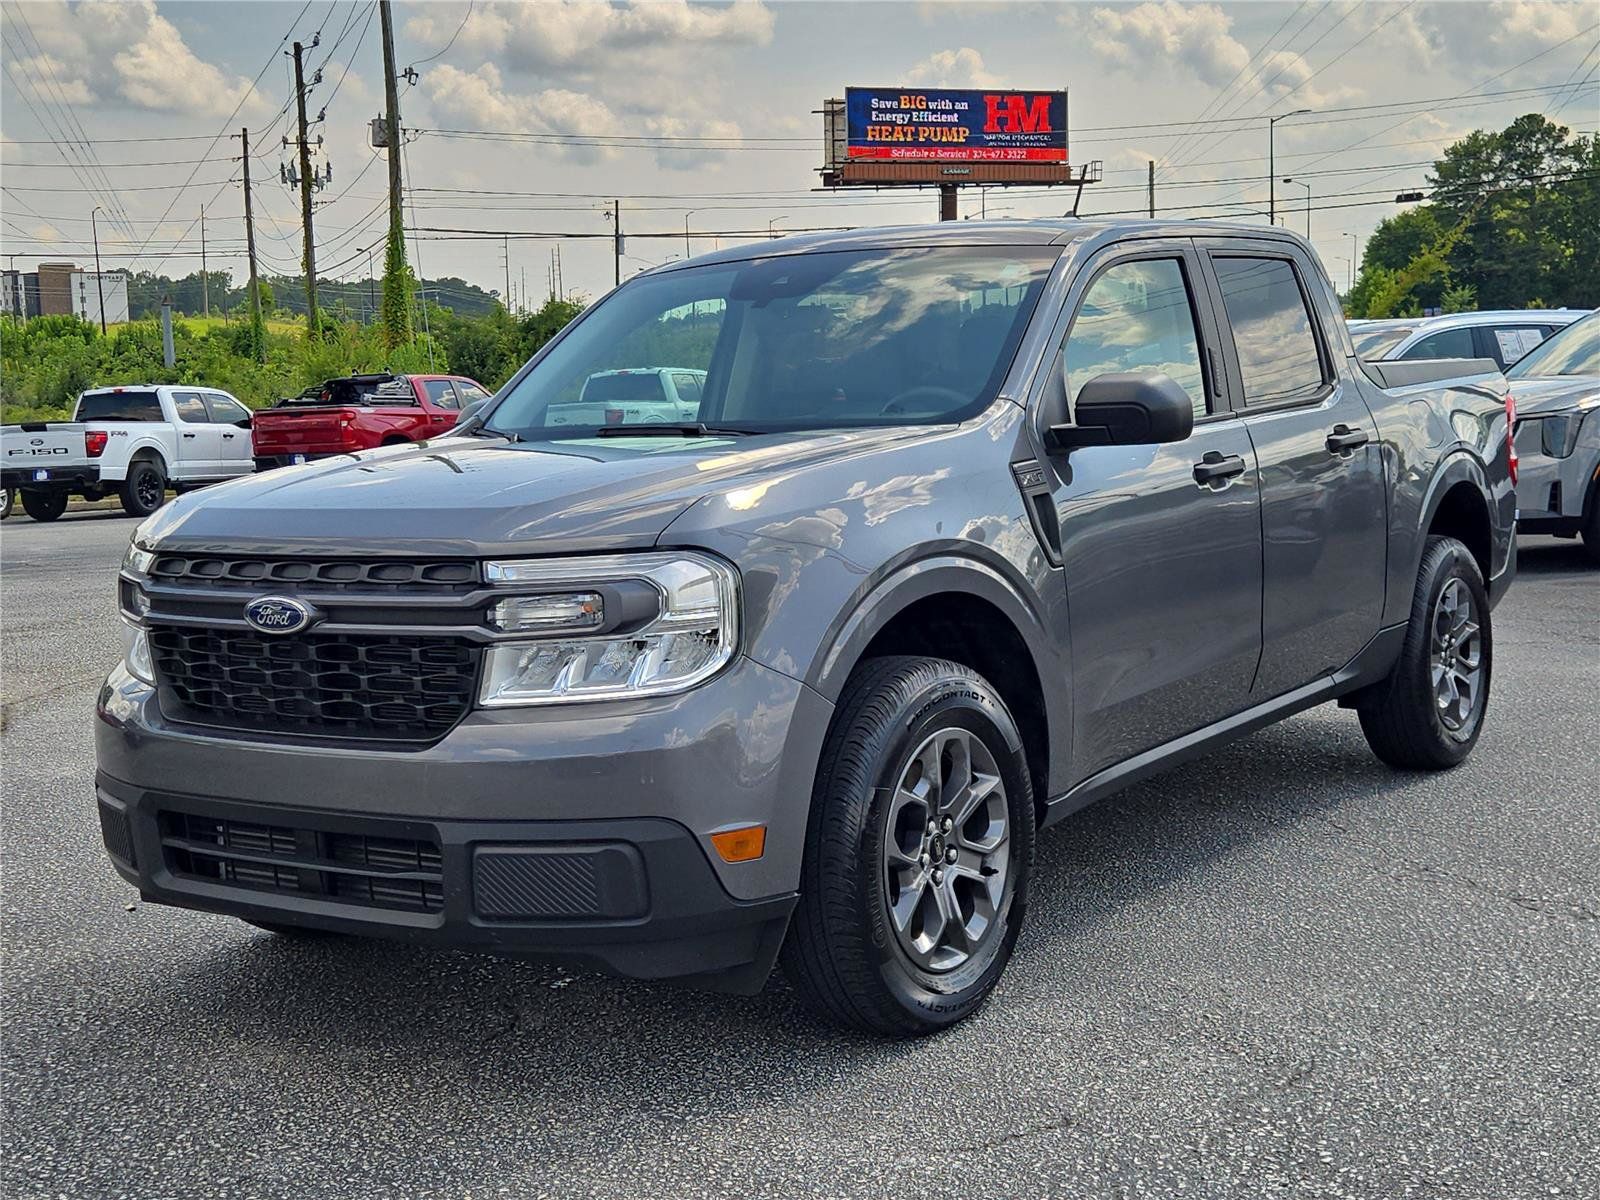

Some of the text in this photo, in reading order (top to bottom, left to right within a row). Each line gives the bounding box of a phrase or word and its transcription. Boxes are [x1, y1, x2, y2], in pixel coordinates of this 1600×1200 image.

[871, 95, 969, 110] Save BIG with an
[871, 111, 959, 124] Energy Efficient
[983, 95, 1052, 133] HM
[867, 125, 970, 142] HEAT PUMP
[891, 149, 929, 158] Schedule
[8, 447, 69, 457] F-150
[257, 604, 292, 625] Ford
